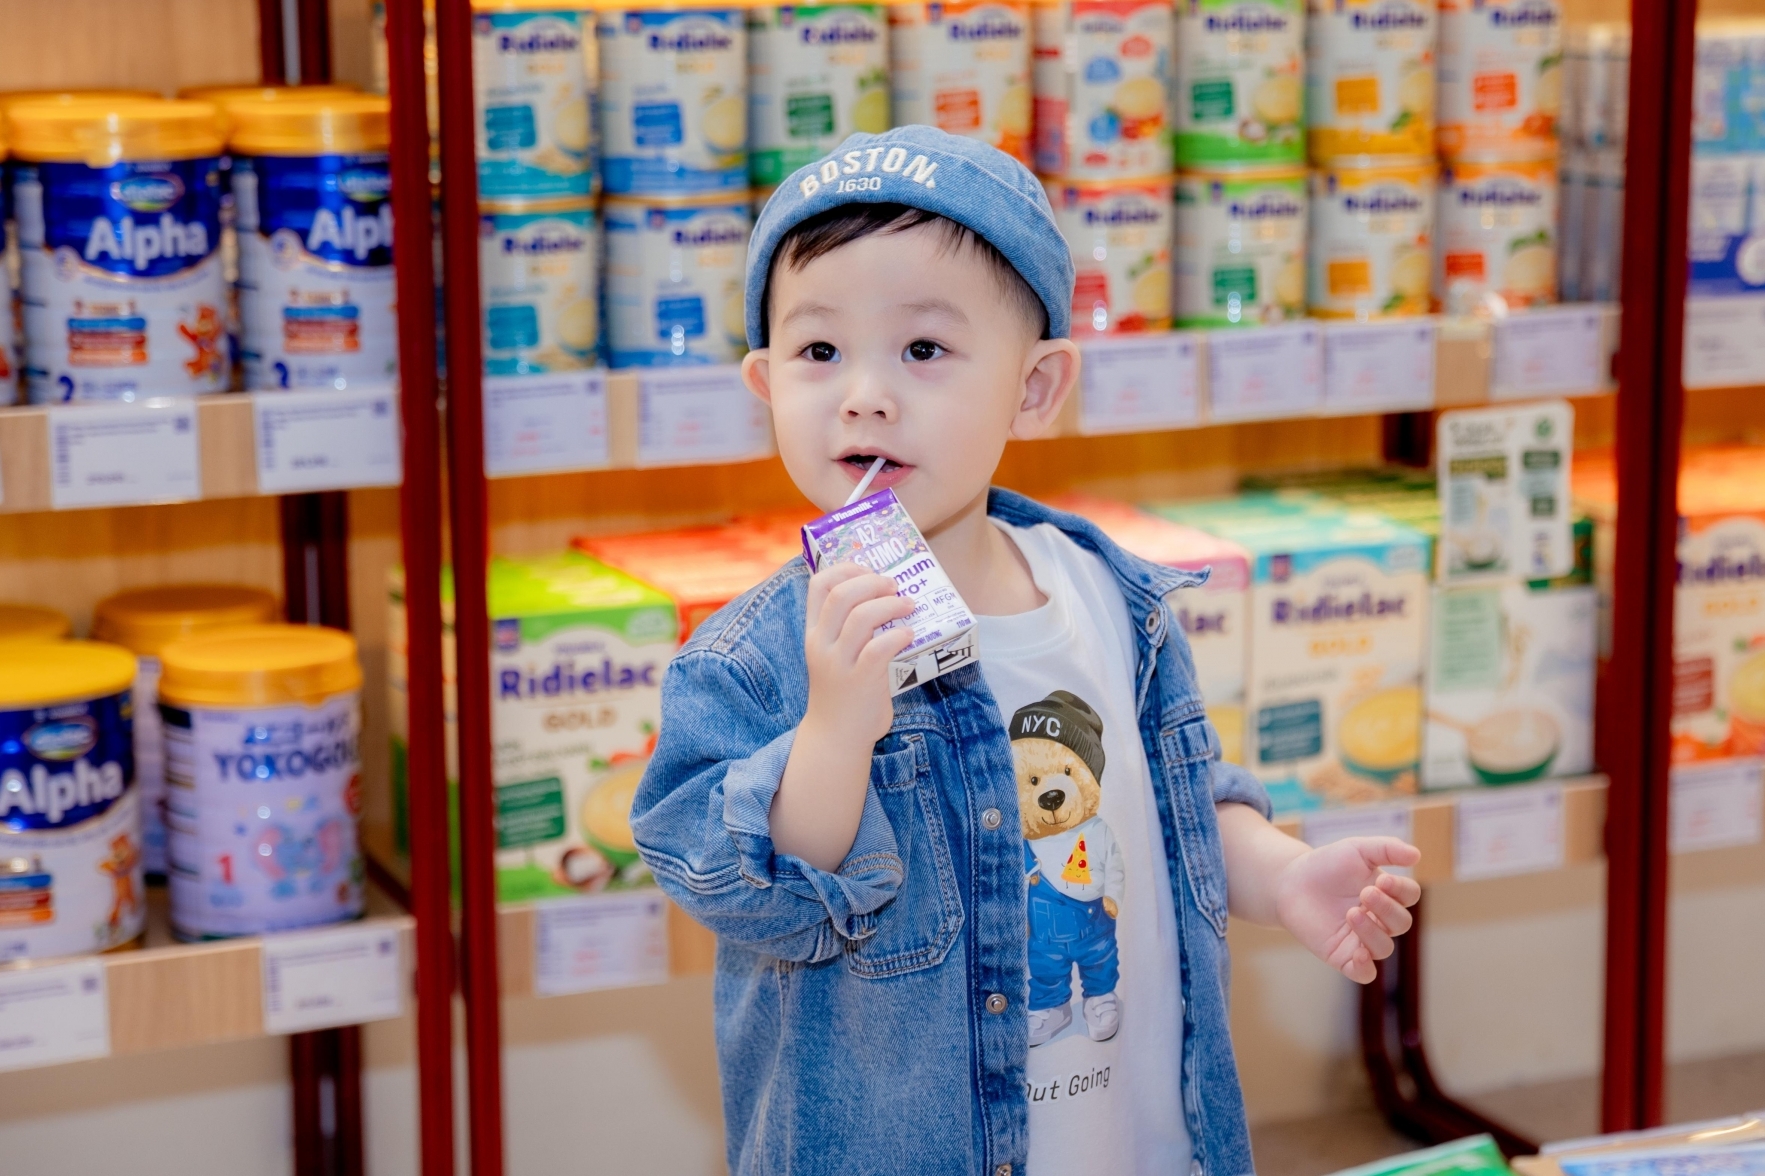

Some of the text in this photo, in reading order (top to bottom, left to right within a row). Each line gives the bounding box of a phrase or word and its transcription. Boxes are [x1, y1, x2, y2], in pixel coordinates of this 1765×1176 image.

[836, 176, 882, 194] 1630
[84, 212, 208, 271] Alpha
[832, 502, 873, 522] Vinamilk
[856, 524, 881, 549] A2
[866, 537, 906, 571] HMO
[880, 620, 896, 632] A2
[500, 656, 658, 702] Ridielac
[1021, 714, 1062, 738] NYC
[213, 742, 358, 784] YOKOGO
[0, 756, 124, 824] Alpha
[218, 851, 236, 886] 1
[1068, 1065, 1111, 1097] Going
